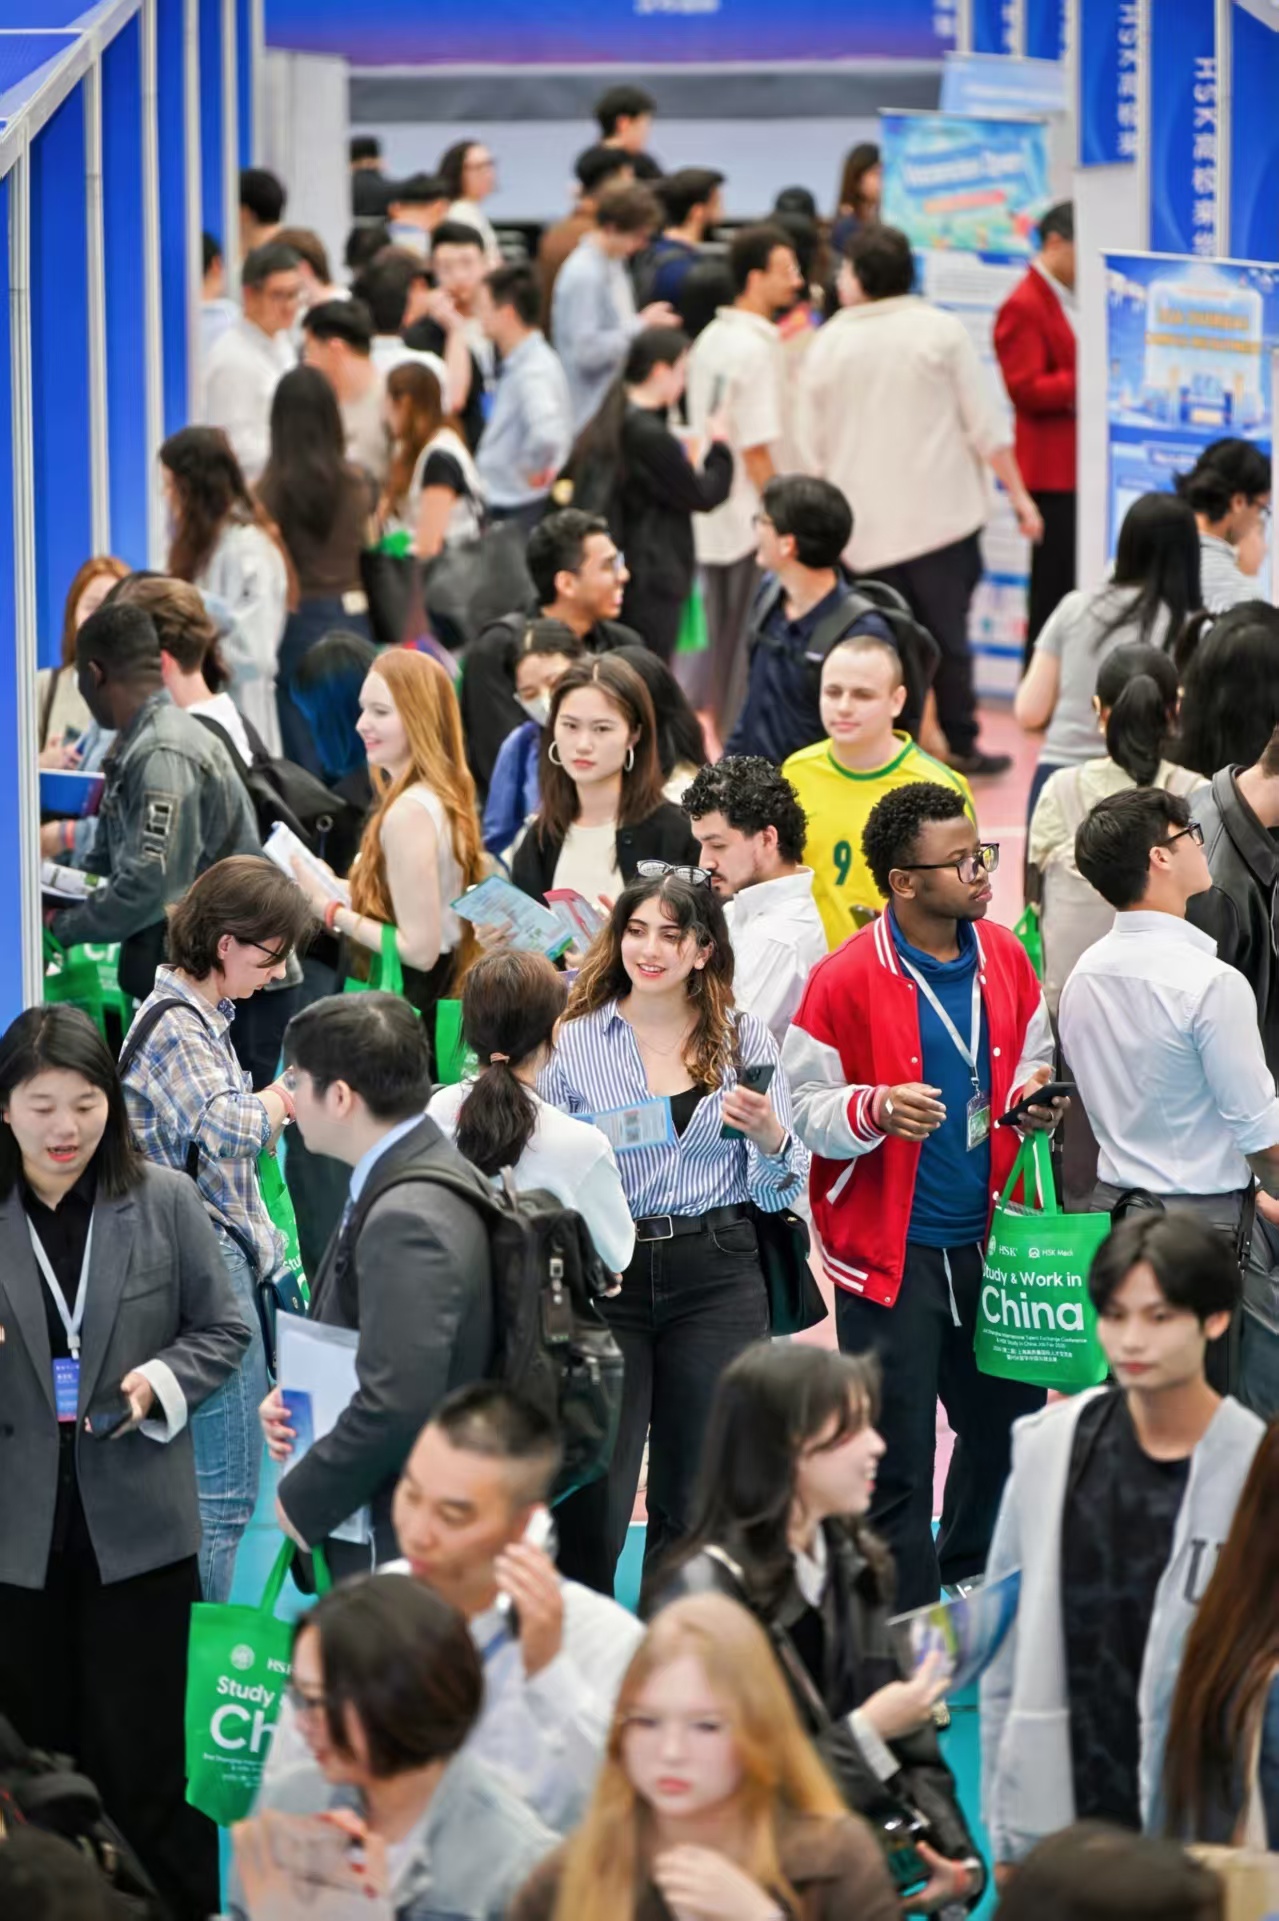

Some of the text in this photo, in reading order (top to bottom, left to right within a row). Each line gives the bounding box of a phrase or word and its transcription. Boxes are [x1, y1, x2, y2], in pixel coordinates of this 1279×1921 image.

[833, 840, 852, 885] 9
[999, 1245, 1017, 1257] HSK
[1010, 1274, 1017, 1284] &
[1019, 1272, 1064, 1287] Work
[1066, 1272, 1082, 1287] in
[982, 1285, 1085, 1331] China
[216, 1675, 275, 1709] Study
[209, 1703, 276, 1753] Ch
